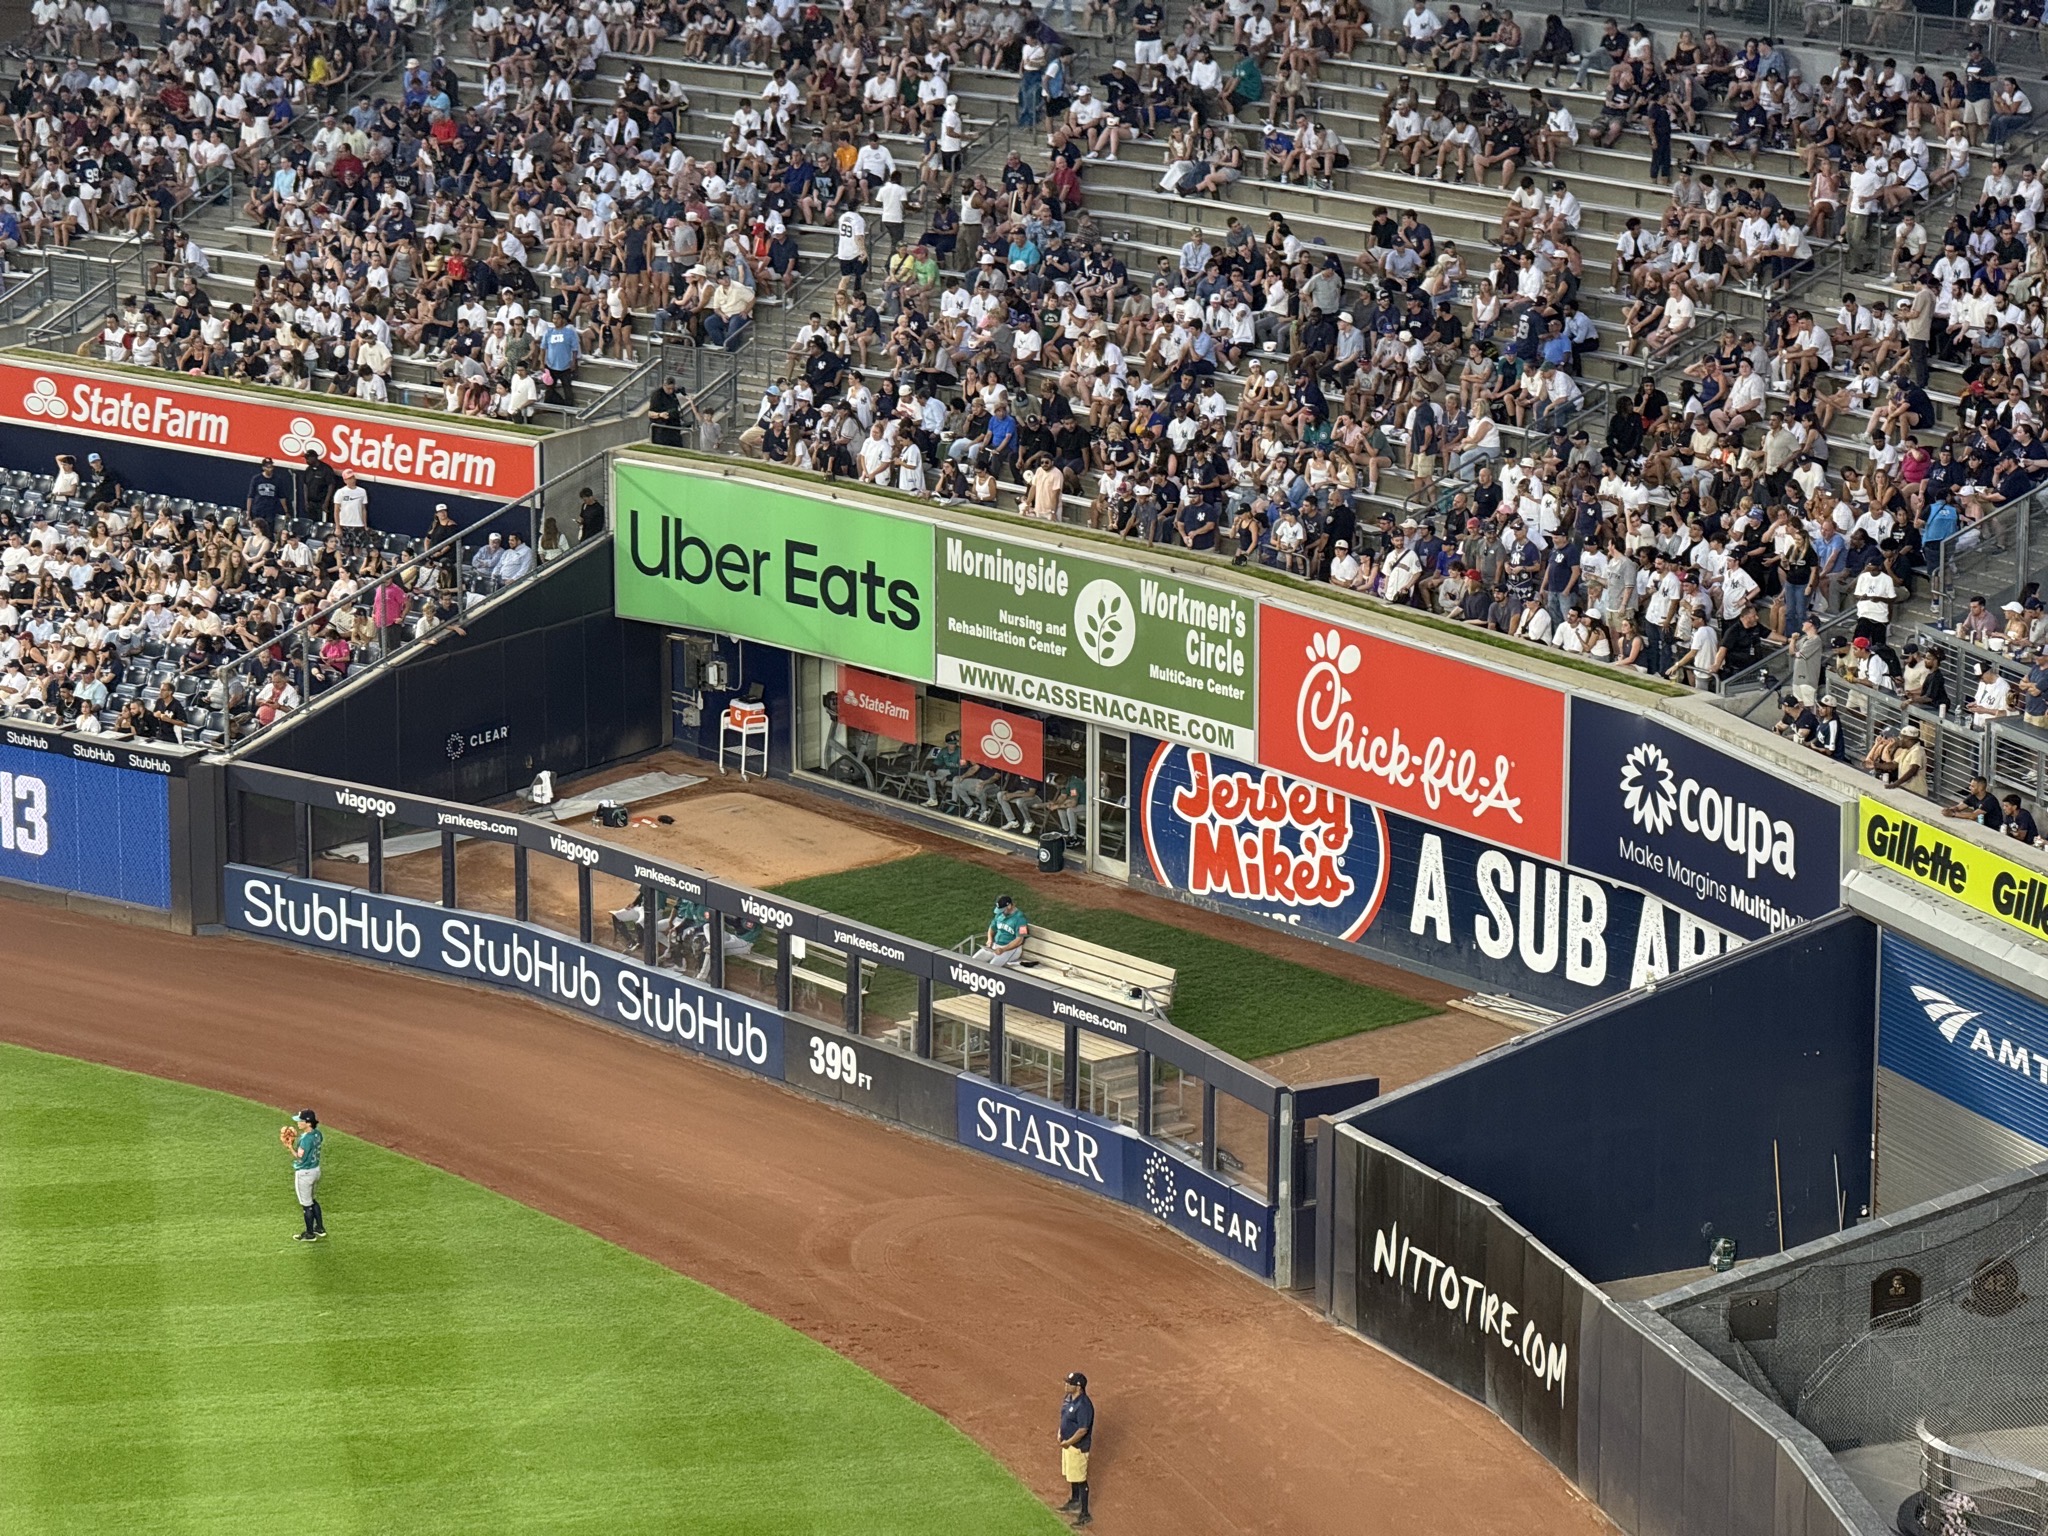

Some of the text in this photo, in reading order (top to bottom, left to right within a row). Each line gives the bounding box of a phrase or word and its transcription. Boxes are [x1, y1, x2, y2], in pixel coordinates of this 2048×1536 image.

[630, 509, 921, 631] Uber Eats
[946, 537, 1068, 596] Morningside
[999, 608, 1067, 638] Nursing and
[1140, 578, 1246, 638] Workmen's
[947, 617, 1067, 657] Rehabilitation Center
[1186, 629, 1245, 677] Circle
[958, 663, 1235, 750] WWW.CASSENACARE.COM
[1149, 664, 1245, 701] MultiCare Center
[6, 731, 48, 750] StubHub
[73, 743, 115, 763] StubHub
[128, 754, 171, 773] StubHub
[469, 726, 508, 747] CLEAR
[1297, 661, 1524, 825] Chick-fil-A
[335, 788, 396, 818] viagogo
[437, 811, 518, 837] yankees.com
[1174, 749, 1351, 852] Jersey
[1679, 778, 1796, 879] coupa
[549, 833, 600, 866] viagogo
[1190, 821, 1352, 904] Mike's
[1619, 836, 1664, 873] Make
[1667, 856, 1727, 903] Margins
[1867, 814, 1967, 894] Gillette
[633, 863, 701, 896] yankees.com
[243, 879, 422, 959] StubHub
[740, 896, 794, 929] viagogo
[1410, 832, 1452, 944] A
[1474, 849, 1608, 987] SUB
[441, 919, 601, 1007] StubHub
[834, 929, 905, 962] yankees.com
[949, 963, 1006, 998] viagogo
[616, 969, 768, 1066] StubHub
[1053, 1000, 1127, 1036] yankees.com
[809, 1036, 873, 1091] 399 FT
[976, 1097, 1105, 1184] STARR
[1184, 1188, 1259, 1253] CLEAR
[1373, 1220, 1568, 1410] NITTOTIRE.COM
